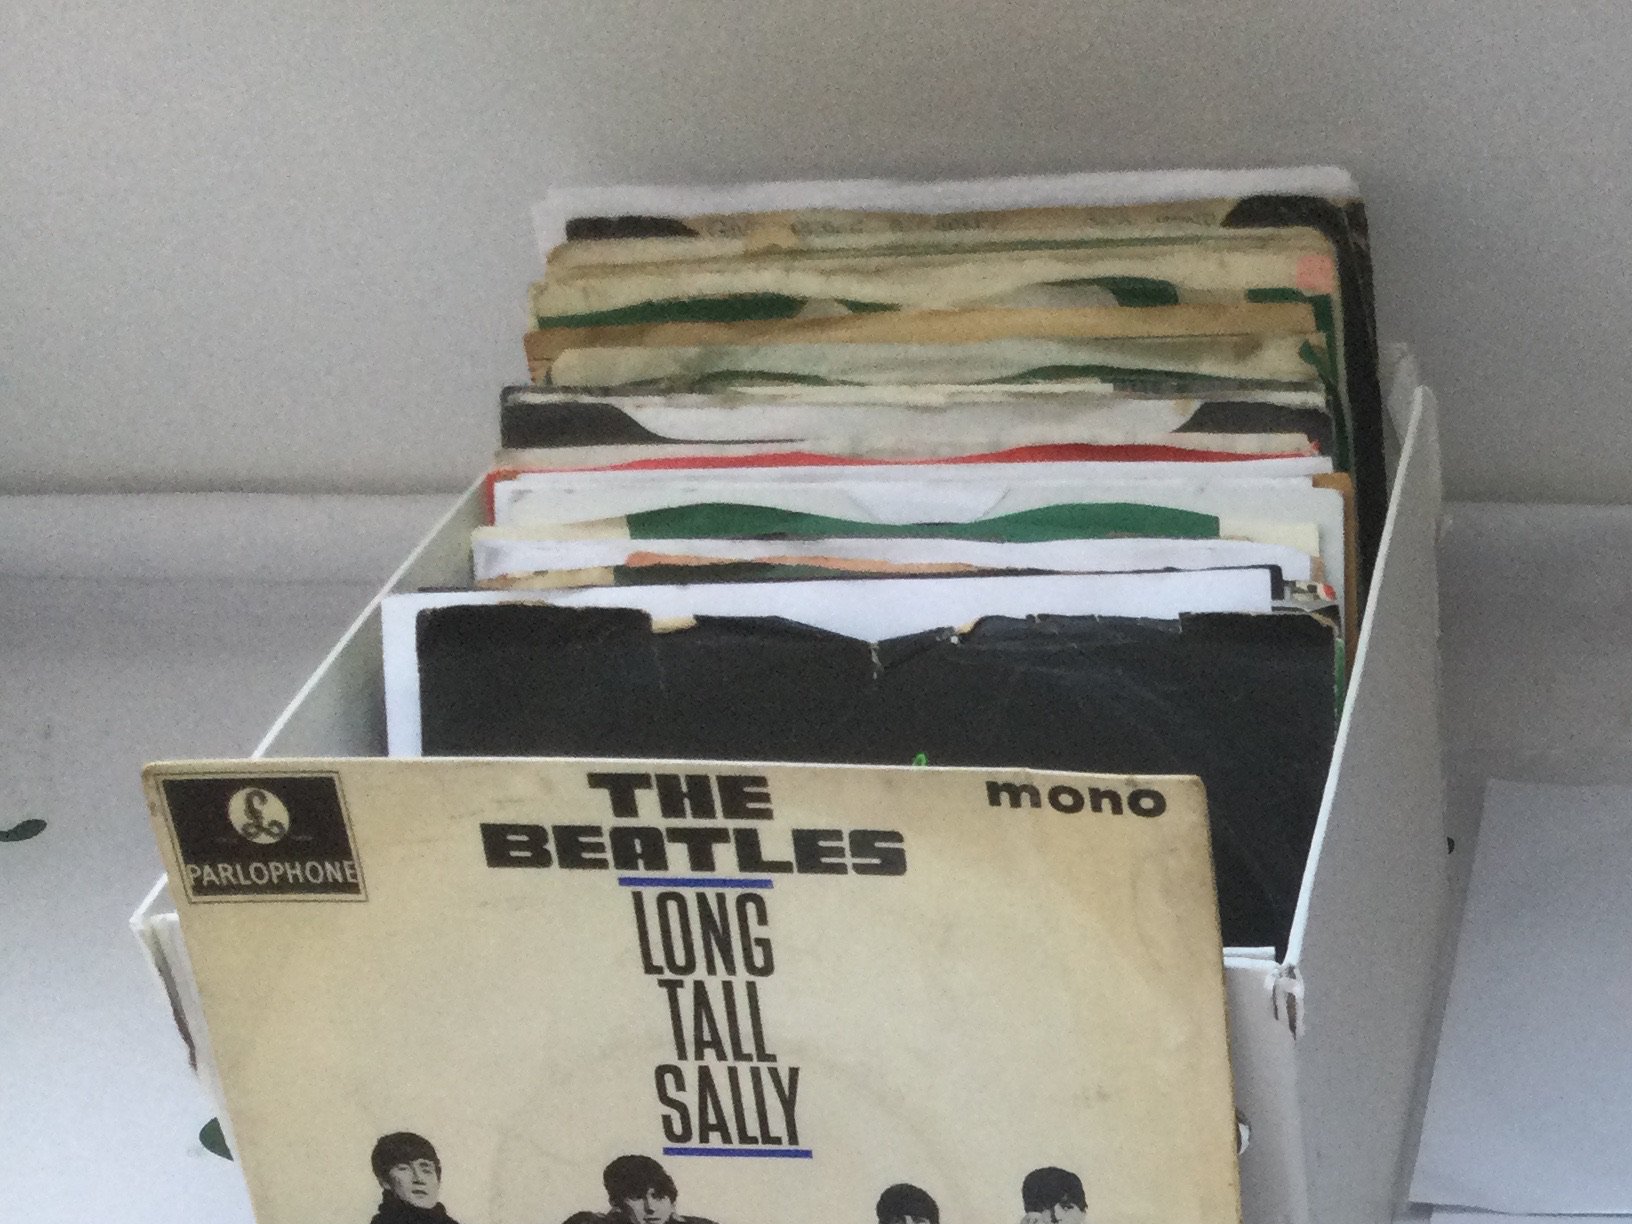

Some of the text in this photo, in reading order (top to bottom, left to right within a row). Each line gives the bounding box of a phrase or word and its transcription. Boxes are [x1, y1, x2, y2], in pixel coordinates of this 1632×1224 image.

[587, 772, 774, 820] THE
[985, 780, 1167, 818] mono
[187, 860, 361, 887] PARLOPHONE
[479, 823, 907, 876] BEATLES
[631, 890, 775, 978] LONG
[657, 979, 777, 1062] TALL
[653, 1064, 801, 1146] SALLY
